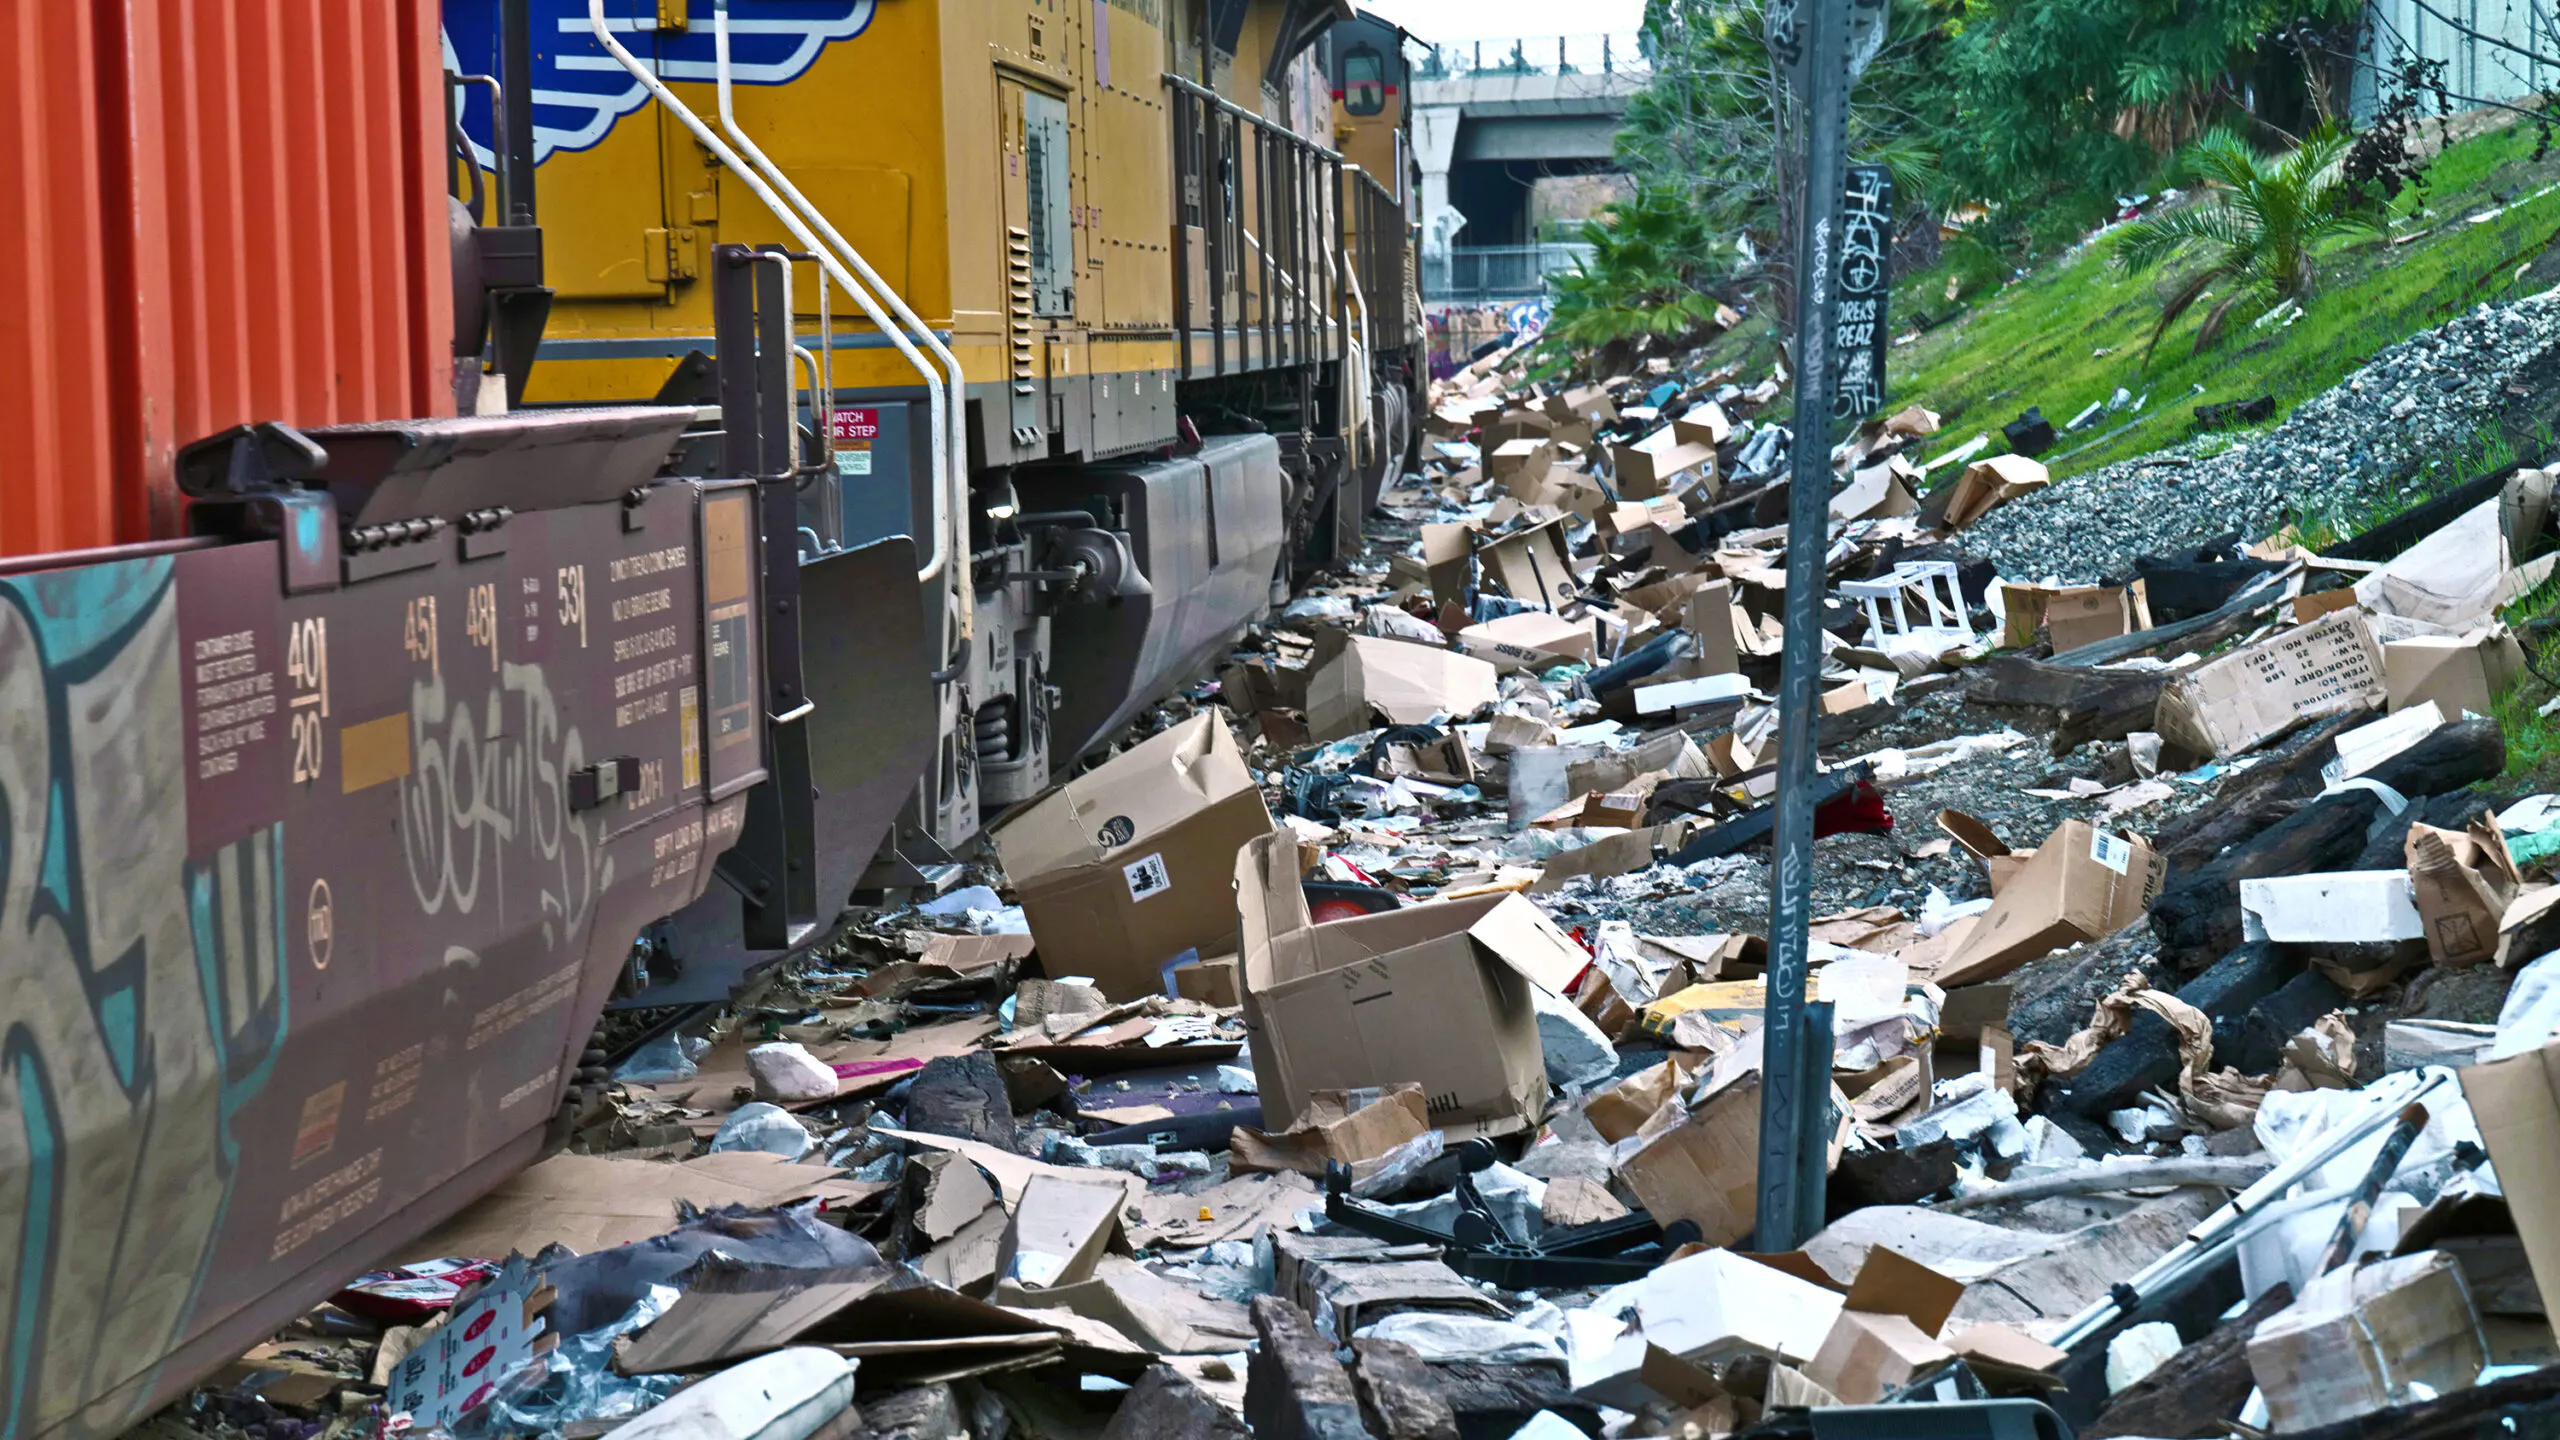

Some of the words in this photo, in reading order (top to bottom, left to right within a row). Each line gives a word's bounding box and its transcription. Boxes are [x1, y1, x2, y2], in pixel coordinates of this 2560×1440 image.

[848, 425, 876, 438] STEP
[2306, 620, 2351, 643] CARTON
[1494, 643, 1523, 658] ROSS
[2341, 664, 2370, 680] ITEM
